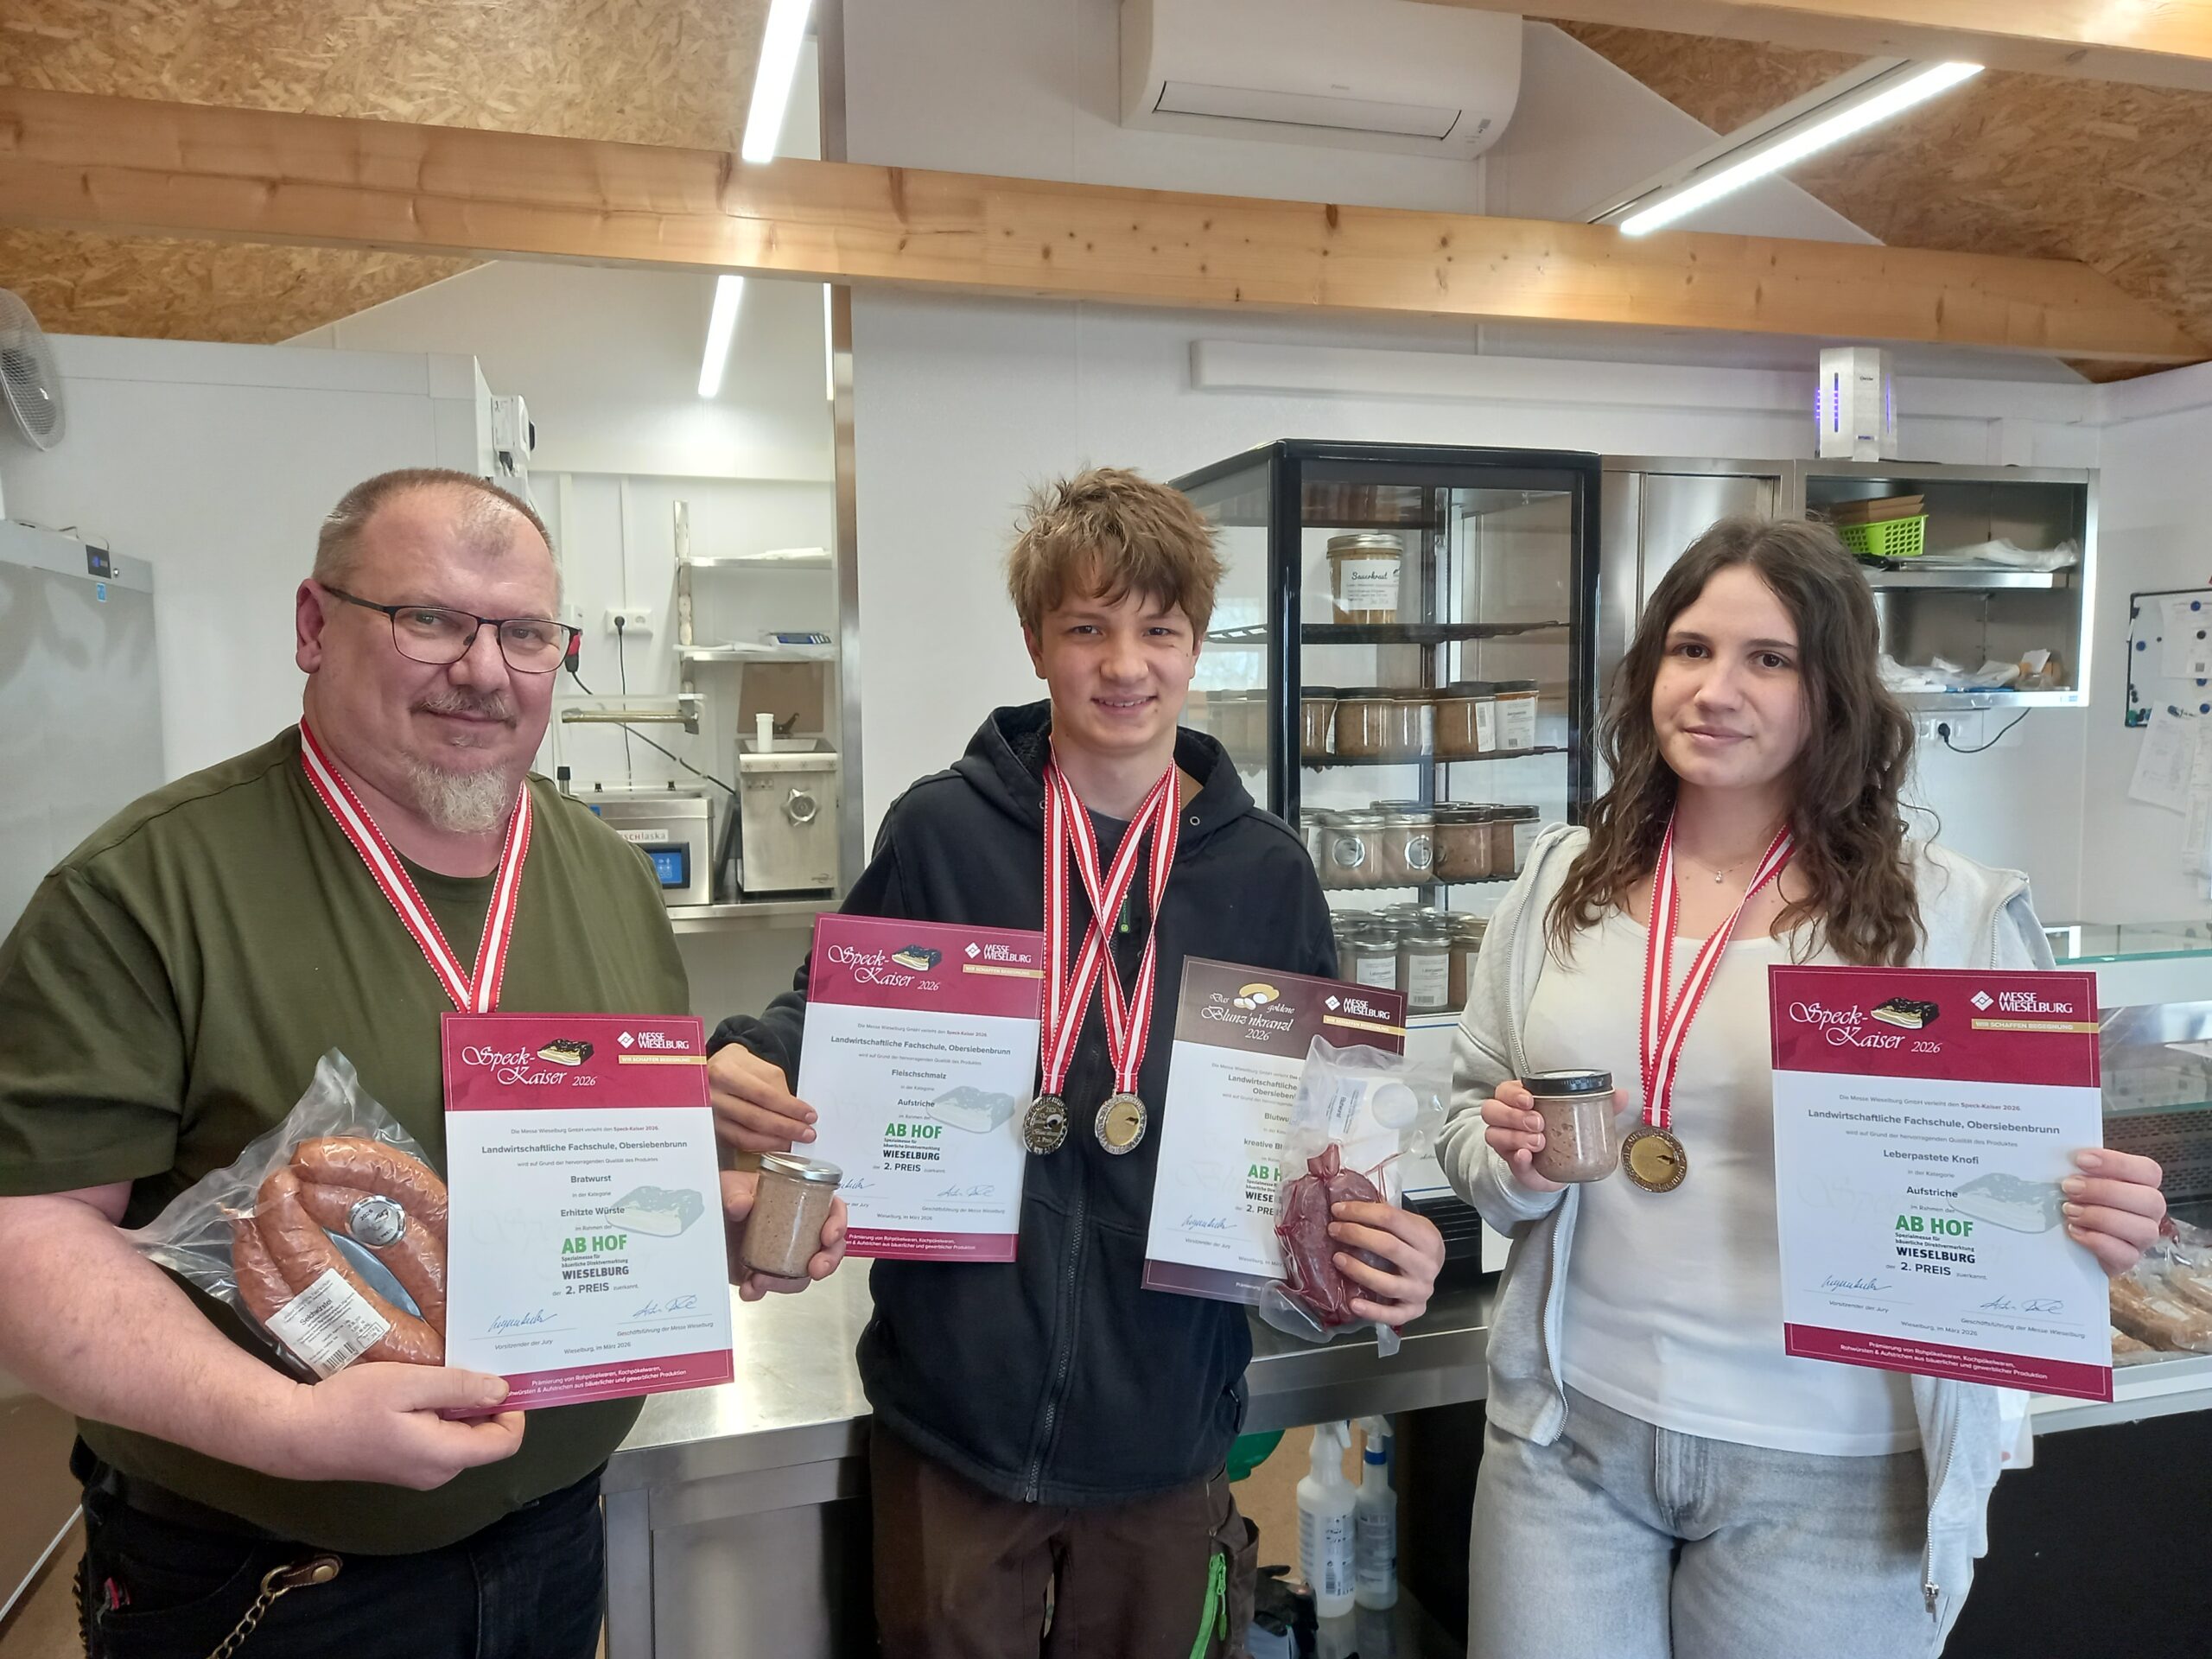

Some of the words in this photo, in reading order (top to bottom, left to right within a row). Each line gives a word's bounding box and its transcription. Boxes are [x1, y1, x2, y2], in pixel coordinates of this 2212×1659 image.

[983, 944, 1009, 955] MESSE
[828, 945, 889, 969] Speck-
[983, 950, 1032, 963] WIESELBURG
[854, 967, 915, 987] Kaiser
[917, 980, 940, 991] 2026
[1209, 992, 1230, 1003] Das
[1343, 997, 1370, 1010] MESSE
[1999, 991, 2037, 1004] MESSE
[1266, 1003, 1295, 1014] goldene
[1343, 1004, 1390, 1020] WIESELBURG
[1998, 1001, 2073, 1014] WIESELBURG
[1789, 1001, 1868, 1030] Speck-
[637, 1032, 667, 1042] MESSE
[1245, 1028, 1272, 1041] 2026
[1826, 1026, 1905, 1049] Kaiser
[1910, 1040, 1942, 1053] 2026
[637, 1040, 690, 1049] WIESELBURG
[830, 1035, 903, 1047] Landwirtschaftliche
[903, 1040, 947, 1051] Fachschule,
[948, 1044, 1011, 1055] Obersiebenbrunn
[461, 1046, 536, 1071] Speck-
[497, 1065, 567, 1085] Kaiser
[572, 1076, 598, 1086] 2026
[891, 1069, 947, 1079] Fleischschmalz
[1227, 1073, 1298, 1090] Landwirtschaftliche
[897, 1098, 935, 1108] Aufstriche
[1808, 1109, 1902, 1123] Landwirtschaftliche
[1904, 1116, 1965, 1128] Fachschule,
[1967, 1120, 2060, 1134] Obersiebenbrunn
[884, 1122, 907, 1137] AB
[911, 1124, 943, 1139] HOF
[481, 1143, 566, 1154] Landwirtschaftliche
[568, 1141, 617, 1151] Fachschule,
[619, 1141, 688, 1149] Obersiebenbrunn
[1243, 1137, 1274, 1149] kreative
[882, 1149, 940, 1160] WIESELBURG
[1883, 1149, 1949, 1162] Leberpastete
[1951, 1154, 1979, 1165] Knofi
[883, 1161, 892, 1170] 2.
[894, 1162, 921, 1172] PREIS
[1247, 1164, 1269, 1179] AB
[570, 1174, 612, 1183] Bratwurst
[1906, 1185, 1958, 1198] Aufstriche
[560, 1208, 594, 1217] Erhitzte
[594, 1205, 625, 1216] Würste
[1246, 1204, 1254, 1212] 2.
[1894, 1214, 1924, 1232] AB
[1930, 1217, 1974, 1237] HOF
[561, 1236, 587, 1255] AB
[591, 1233, 627, 1252] HOF
[1896, 1246, 1975, 1264] WIESELBURG
[562, 1265, 629, 1281] WIESELBURG
[1900, 1262, 1911, 1271] 2.
[1915, 1262, 1951, 1275] PREIS
[565, 1285, 575, 1295] 2.
[578, 1281, 609, 1294] PREIS
